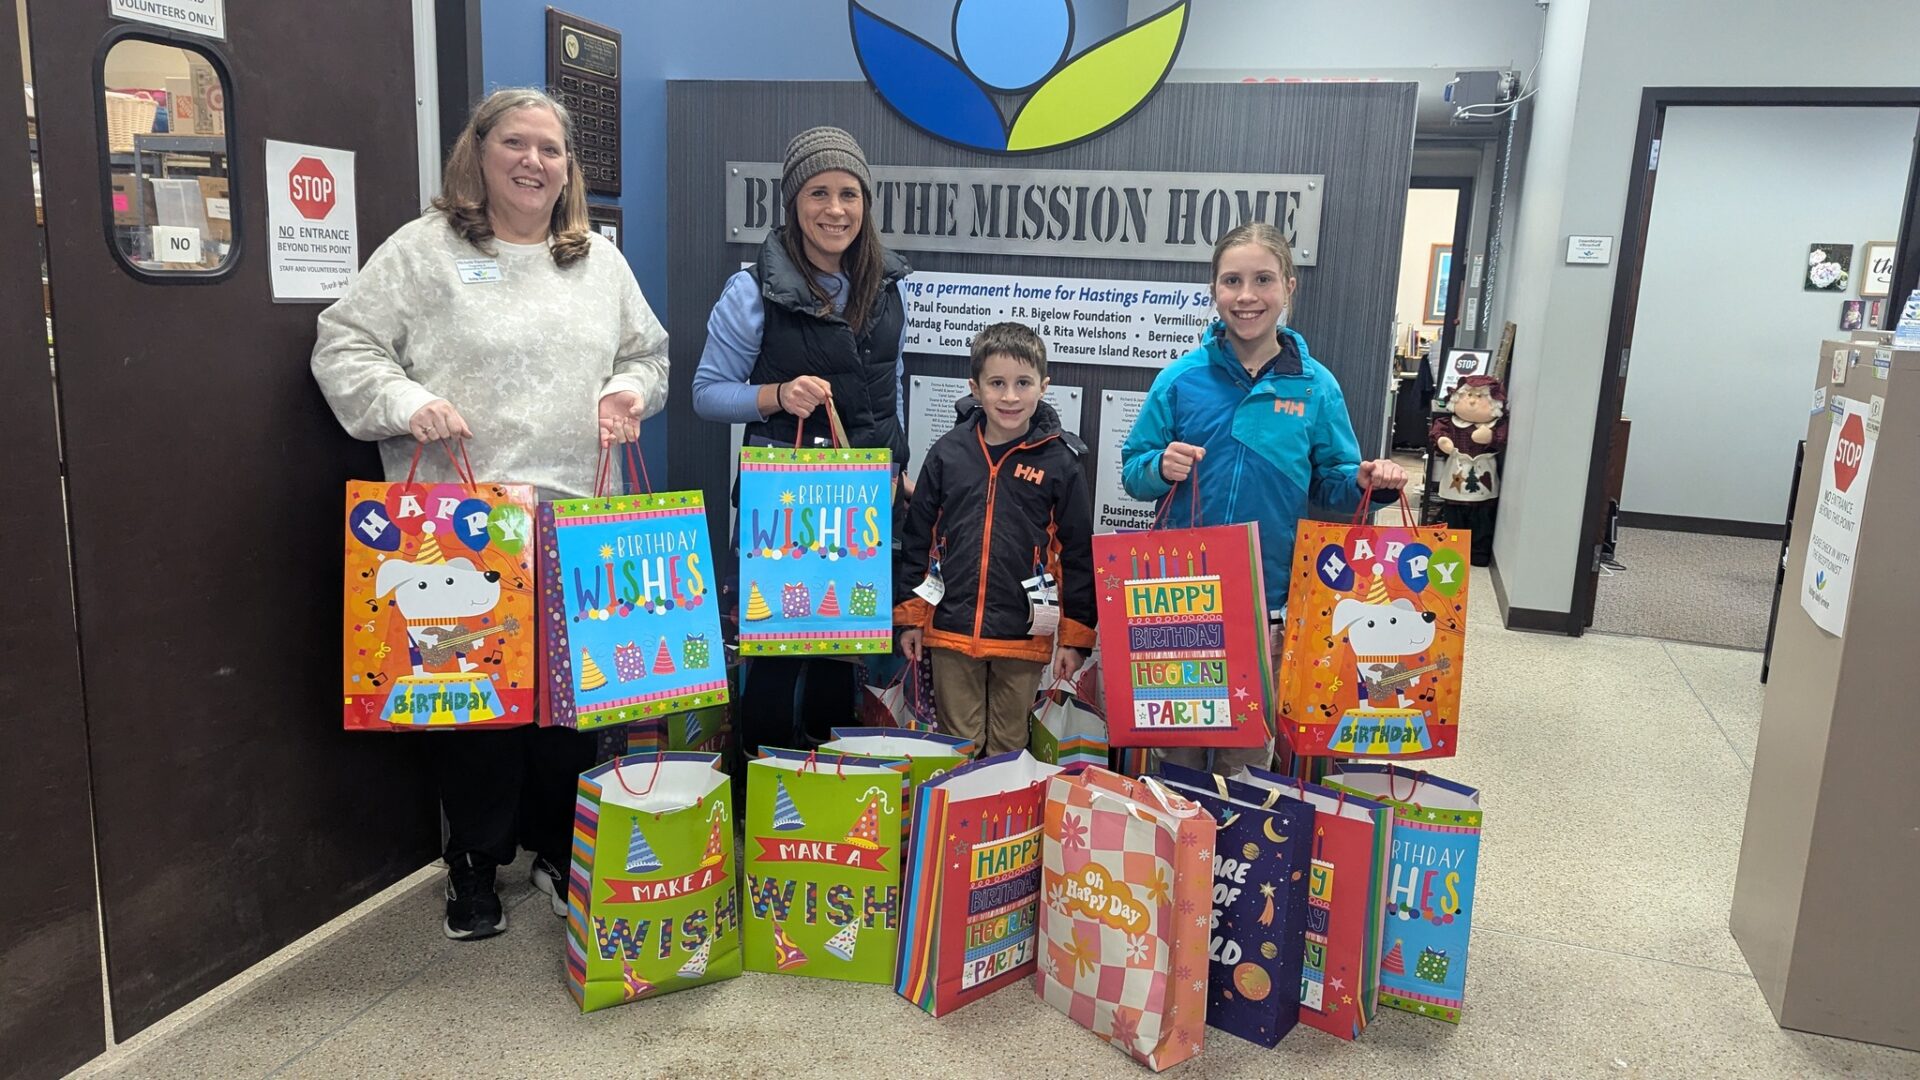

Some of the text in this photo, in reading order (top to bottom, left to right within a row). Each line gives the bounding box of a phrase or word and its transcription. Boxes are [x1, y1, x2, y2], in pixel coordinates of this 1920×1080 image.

[119, 0, 215, 26] VOLUNTEERS ONLY
[292, 174, 332, 203] STOP
[876, 181, 959, 236] THE
[970, 183, 1152, 244] MISSION
[1165, 188, 1301, 249] HOME
[170, 237, 191, 251] NO
[279, 226, 350, 241] NO ENTRANCE
[277, 242, 351, 255] BEYOND THIS POINT
[307, 266, 338, 274] VOLUNTEERS
[925, 283, 934, 293] a
[936, 283, 1010, 298] permanent
[1013, 282, 1051, 300] home
[1055, 285, 1076, 301] for
[1078, 287, 1139, 308] Hastings
[1142, 289, 1189, 310] Family
[913, 301, 934, 313] Paul
[936, 302, 991, 316] Foundation
[1011, 307, 1028, 318] F.R.
[1031, 307, 1071, 322] Bigelow
[1073, 309, 1132, 323] Foundation
[1153, 313, 1209, 327] Vermillion
[906, 318, 941, 332] Mardag
[944, 319, 988, 332] Foundati
[1043, 326, 1051, 336] &
[1054, 325, 1074, 337] Rita
[1077, 326, 1127, 340] Welshons
[1148, 330, 1194, 344] Berniece
[939, 336, 963, 347] Leon
[1053, 342, 1096, 355] Treasure
[1099, 345, 1129, 357] Island
[1132, 347, 1167, 359] Resort
[1170, 349, 1178, 360] &
[1457, 360, 1477, 369] STOP
[1274, 398, 1305, 416] HH
[1836, 438, 1863, 469] STOP
[1013, 463, 1045, 485] HH
[799, 484, 880, 505] BIRTHDAY
[358, 494, 520, 542] HAPPY
[752, 506, 880, 551] WISHES
[617, 529, 698, 558] BIRTHDAY
[1321, 538, 1459, 584] HAPPY
[573, 553, 705, 612] WISHES
[1132, 584, 1215, 616] HAPPY
[1136, 661, 1223, 687] HOORAY
[1147, 700, 1215, 726] PARTY
[780, 842, 861, 867] MAKE A
[977, 832, 1042, 879] HAPPY
[632, 869, 713, 901] MAKE A
[1085, 870, 1104, 890] Oh
[745, 873, 898, 930] WISH
[1066, 878, 1142, 926] Happy Day
[1212, 883, 1242, 907] OF
[591, 886, 737, 961] WISH
[968, 902, 1037, 949] HOORAY
[974, 940, 1026, 983] PARTY
